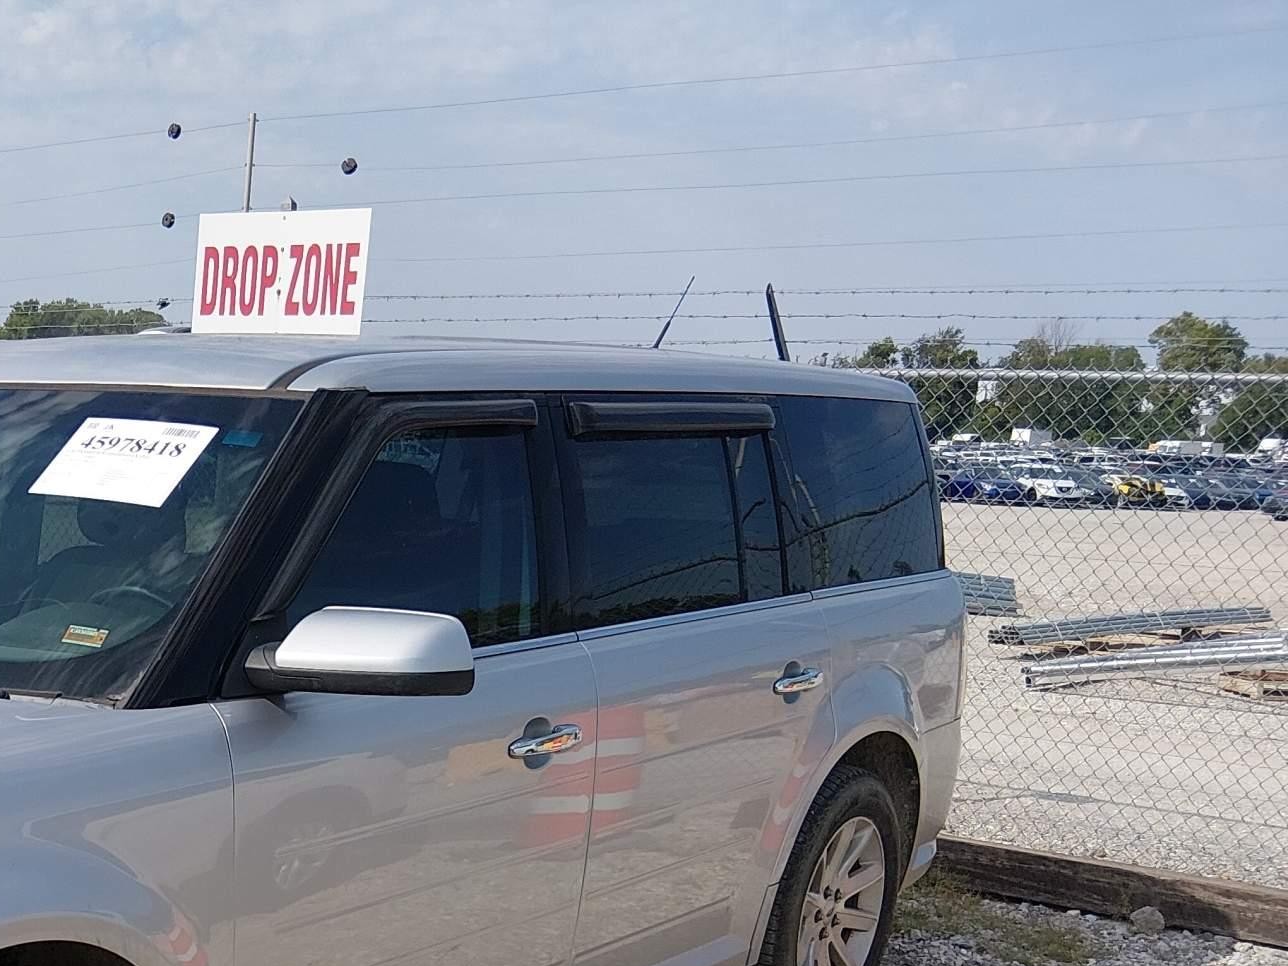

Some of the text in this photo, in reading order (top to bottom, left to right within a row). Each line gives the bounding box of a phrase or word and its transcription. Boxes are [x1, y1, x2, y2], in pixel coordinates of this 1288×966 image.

[199, 242, 361, 316] DROP ZONE
[80, 435, 187, 458] 45978418
